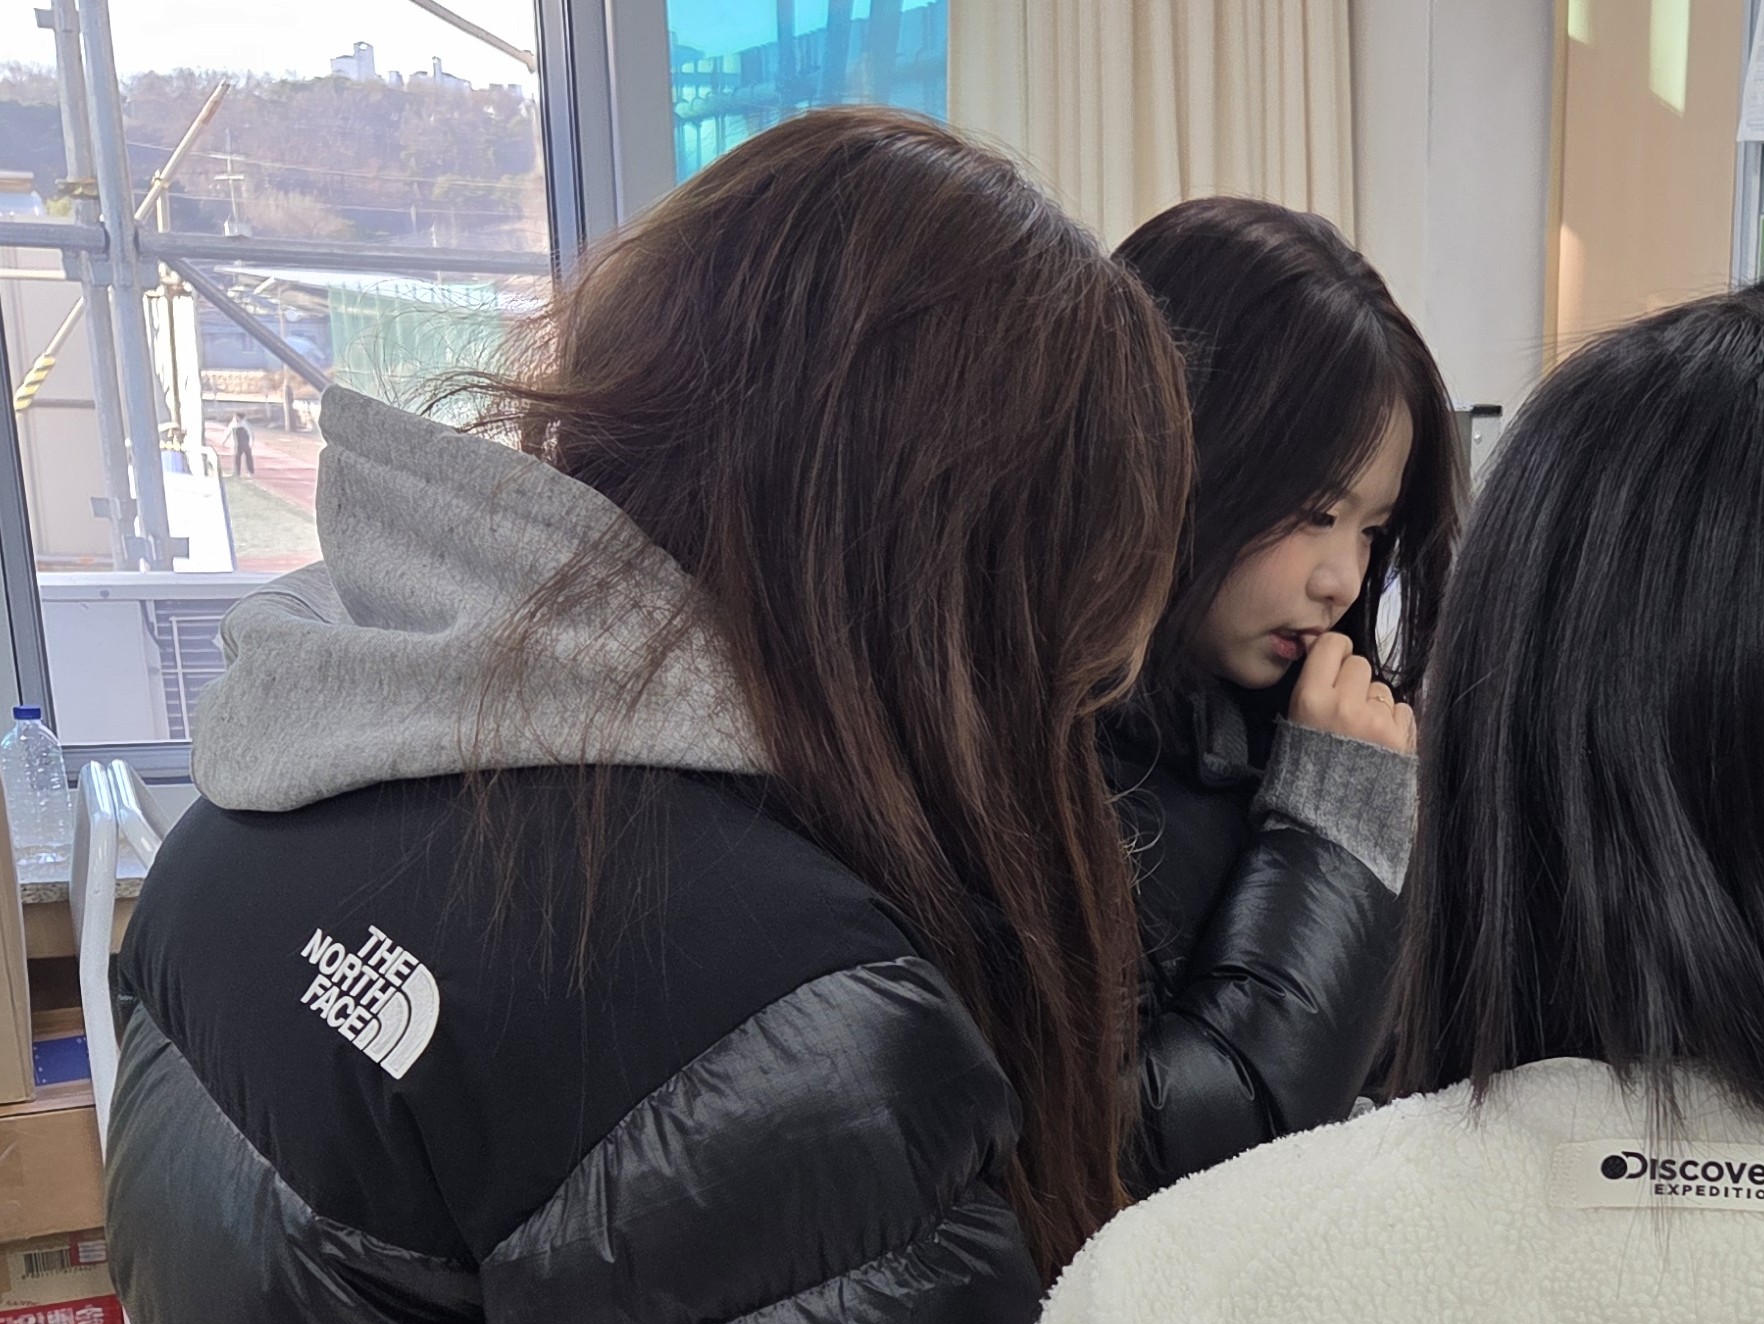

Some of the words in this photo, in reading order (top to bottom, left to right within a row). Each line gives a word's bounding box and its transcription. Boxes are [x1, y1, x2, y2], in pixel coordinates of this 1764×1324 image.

[301, 928, 397, 1014] NORTH
[357, 925, 420, 987] THE
[301, 974, 373, 1041] FACE
